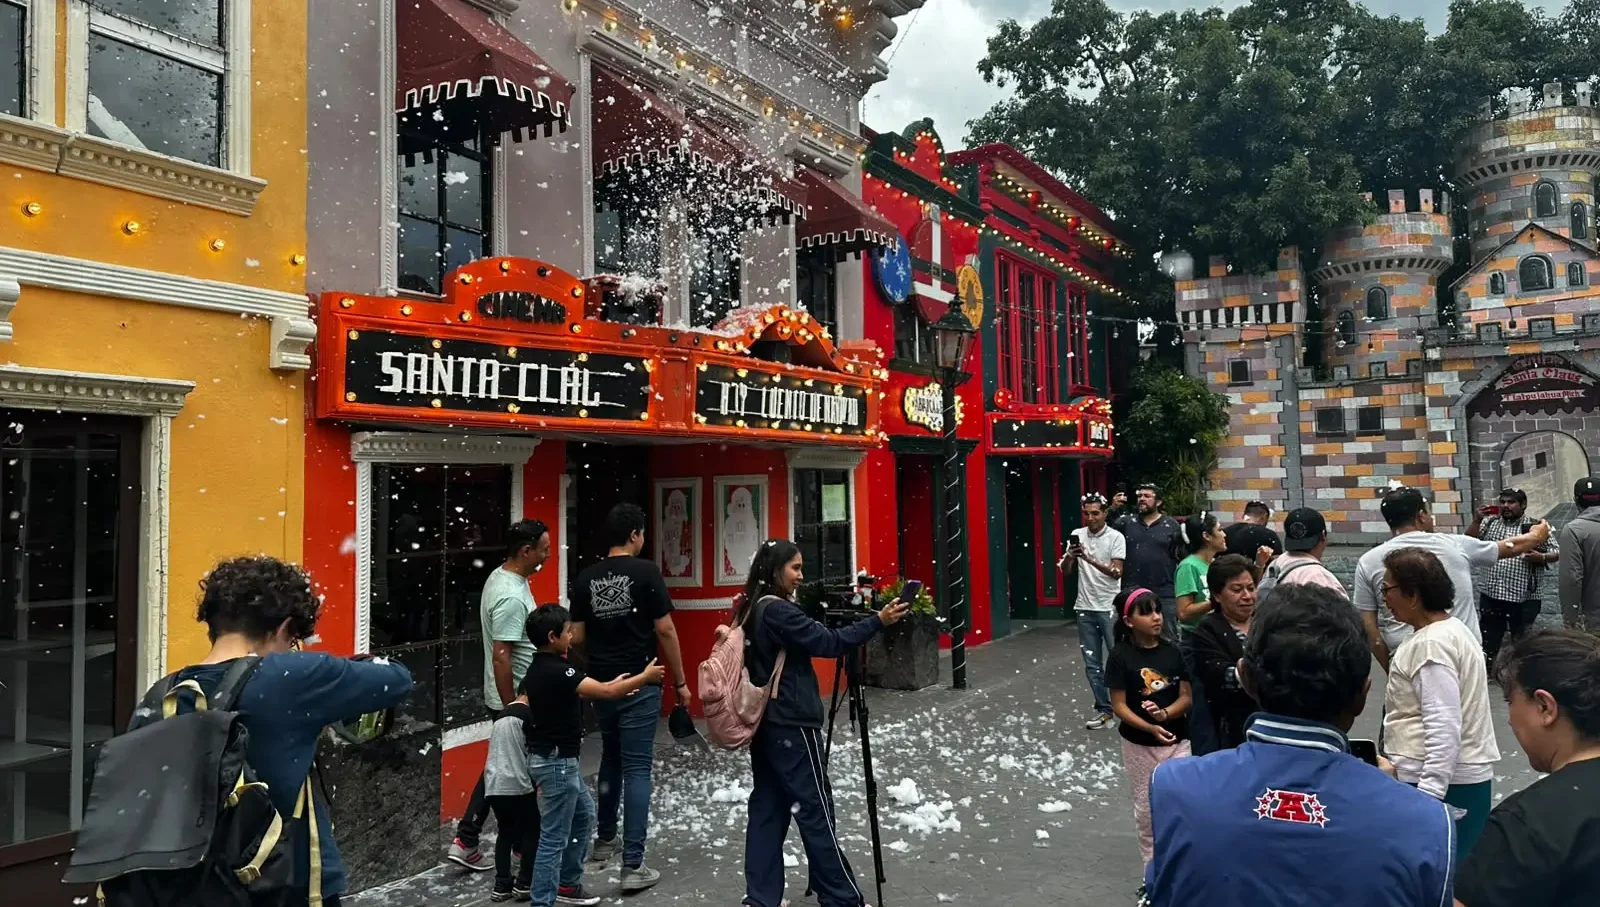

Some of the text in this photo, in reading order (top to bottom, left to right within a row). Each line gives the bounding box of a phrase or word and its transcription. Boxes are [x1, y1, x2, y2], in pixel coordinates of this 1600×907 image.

[381, 352, 499, 399] SANTA
[1502, 368, 1582, 385] Santa Claus
